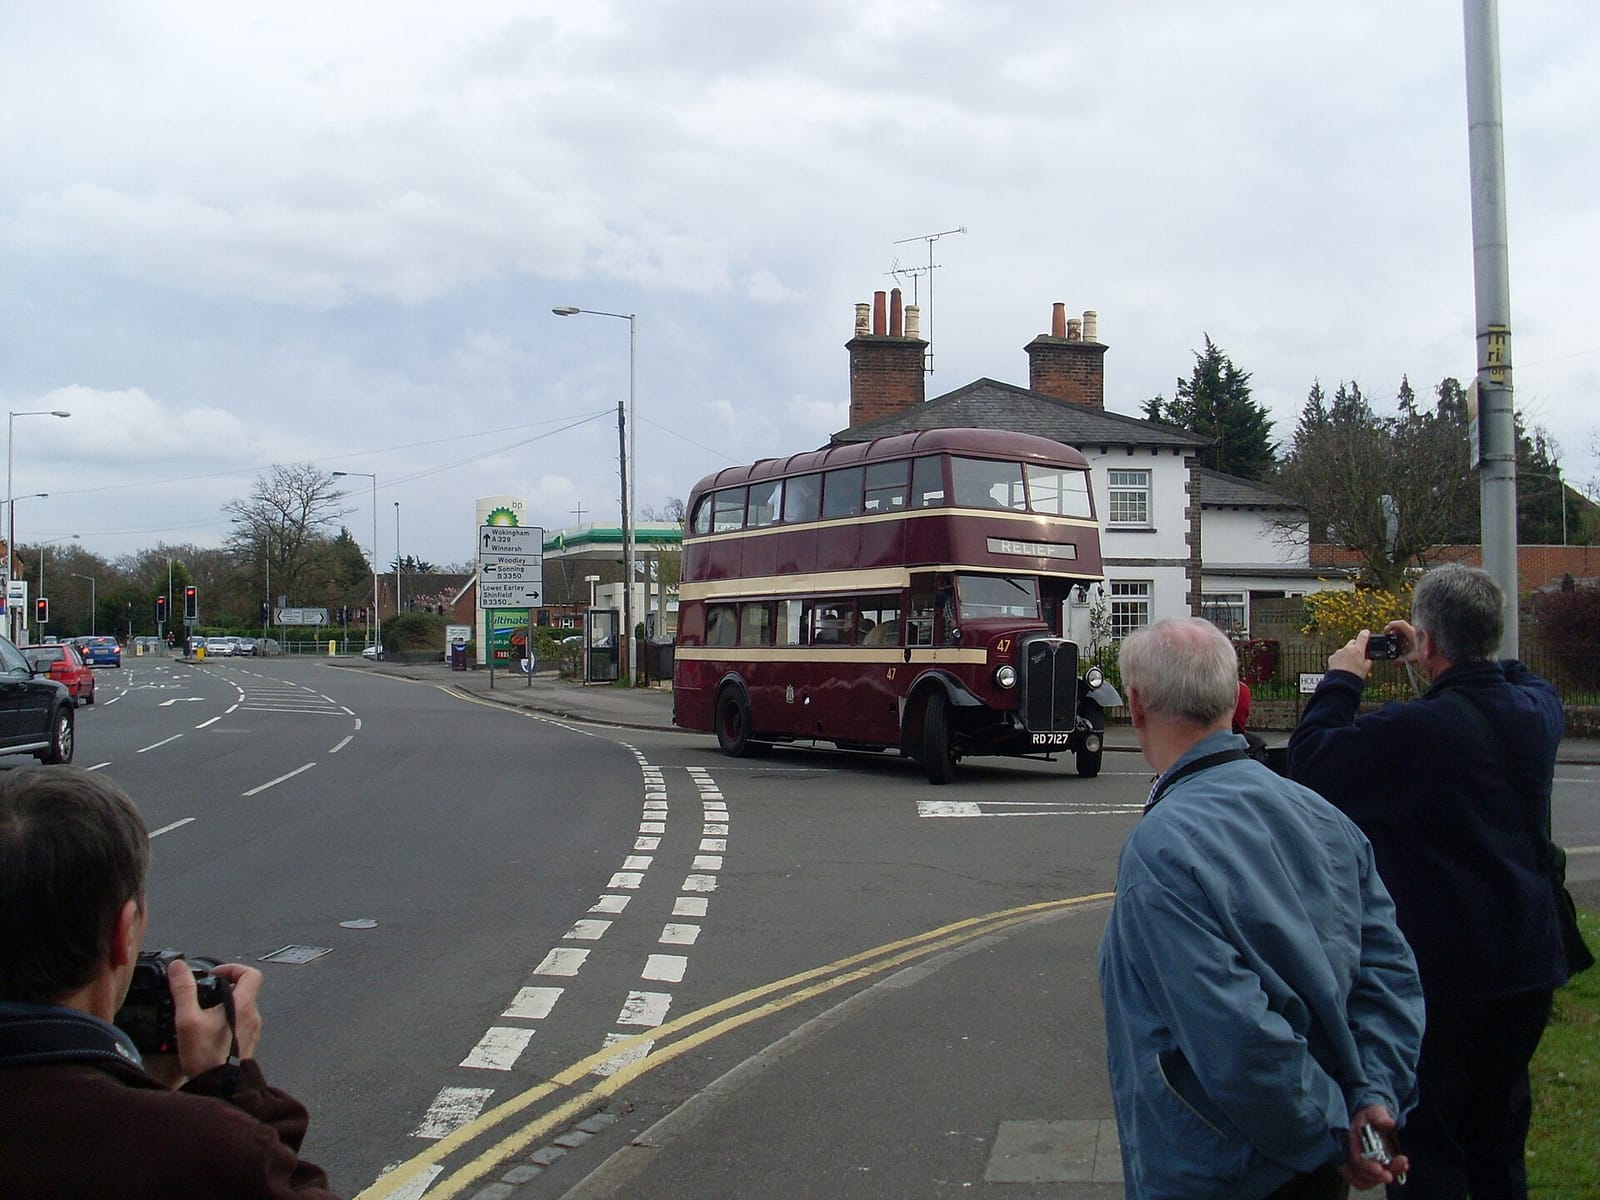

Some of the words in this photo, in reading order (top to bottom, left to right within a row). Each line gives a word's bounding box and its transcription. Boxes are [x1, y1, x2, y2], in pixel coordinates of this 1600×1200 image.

[512, 501, 523, 509] bp
[491, 529, 530, 537] Wokingham
[1001, 540, 1056, 556] RELIEF
[498, 556, 526, 565] Woodley
[503, 584, 525, 592] Earley
[482, 598, 507, 606] B3350
[996, 639, 1011, 653] 47
[886, 667, 897, 681] 47
[1032, 733, 1046, 744] RD
[1047, 733, 1069, 744] 7127
